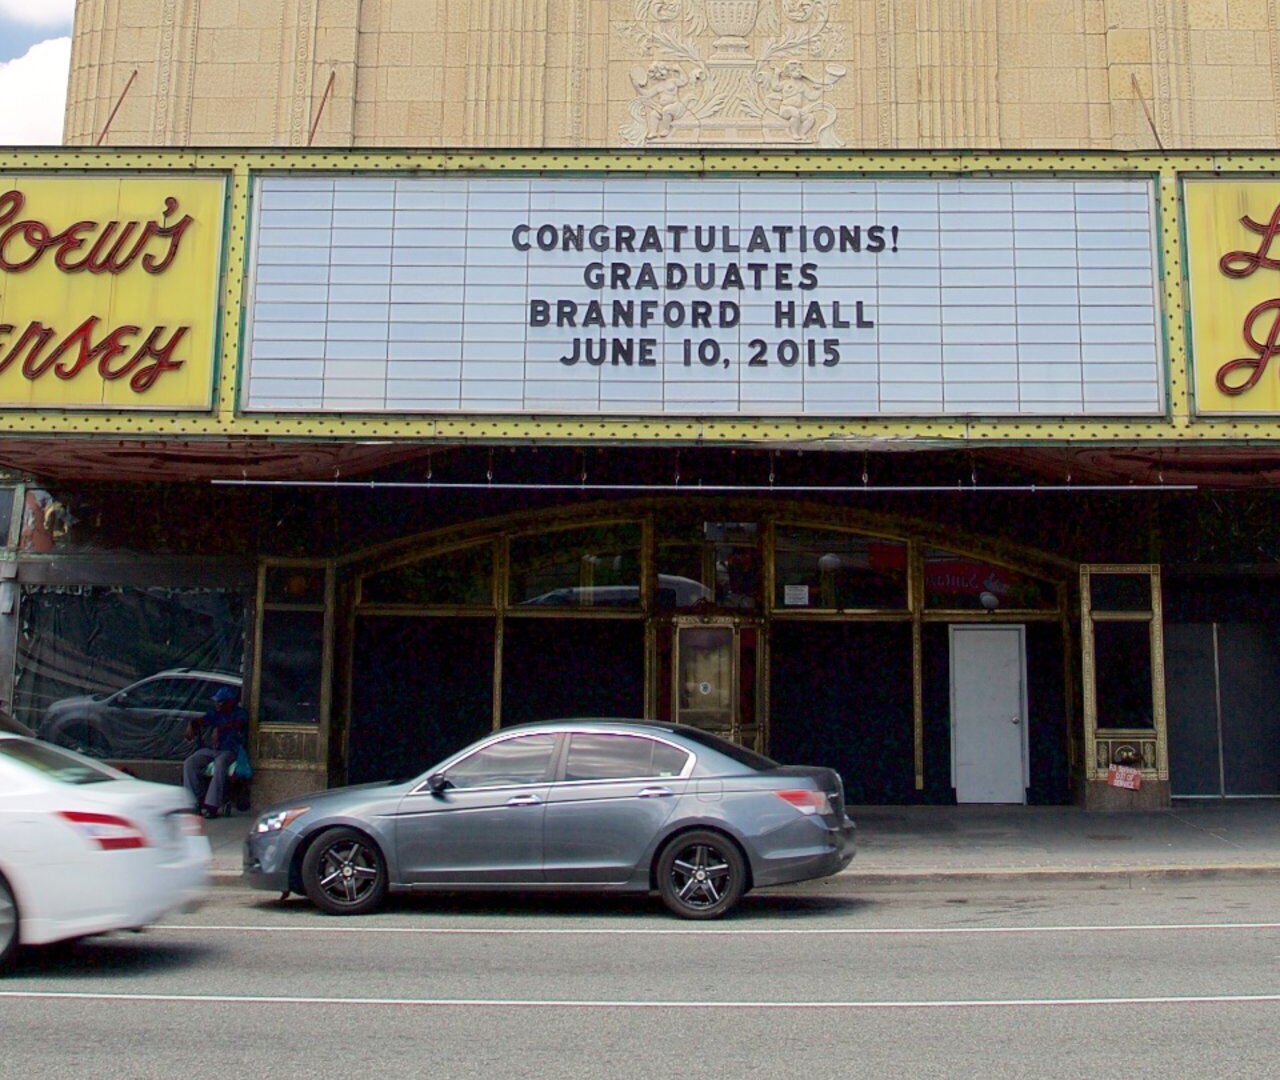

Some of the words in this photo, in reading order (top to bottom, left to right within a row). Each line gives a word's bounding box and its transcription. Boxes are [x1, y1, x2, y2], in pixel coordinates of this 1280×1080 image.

[511, 224, 899, 253] CONGRATULATIONS!
[584, 262, 819, 291] GRADUATES
[529, 299, 741, 328] BRANFORD
[774, 300, 874, 328] HALL
[559, 338, 657, 366] JUNE
[683, 338, 731, 369] 10,
[748, 338, 841, 367] 2015
